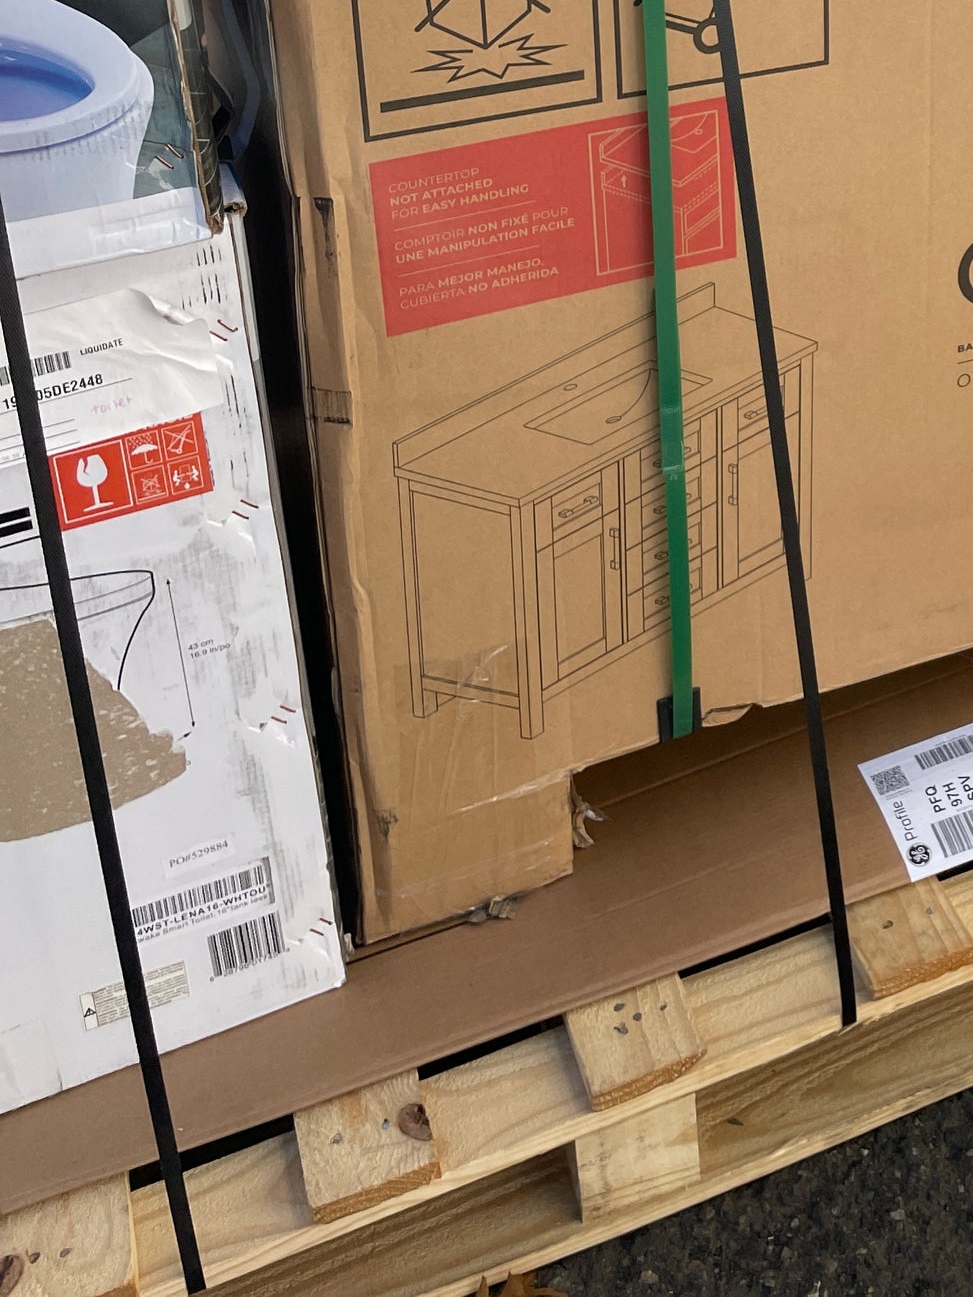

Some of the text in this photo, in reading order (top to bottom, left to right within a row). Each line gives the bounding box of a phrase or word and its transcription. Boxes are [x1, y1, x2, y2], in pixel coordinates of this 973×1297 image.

[388, 167, 479, 194] COUNTERTOP
[390, 178, 493, 207] NOT ATTACHED
[391, 184, 529, 221] FOR EASY HANDLING
[394, 206, 569, 251] COMPTOIR NON FIXÉ POUR
[395, 218, 575, 264] UNE MANIPULATION FACILE
[399, 281, 434, 297] PARA
[438, 270, 483, 288] MEJOR
[400, 267, 559, 310] CUBIERTA NO ADHERIDA
[79, 338, 123, 356] LIQUIDATE
[925, 785, 946, 814] PFQ
[943, 782, 963, 808] 97H
[893, 800, 918, 842] Profile
